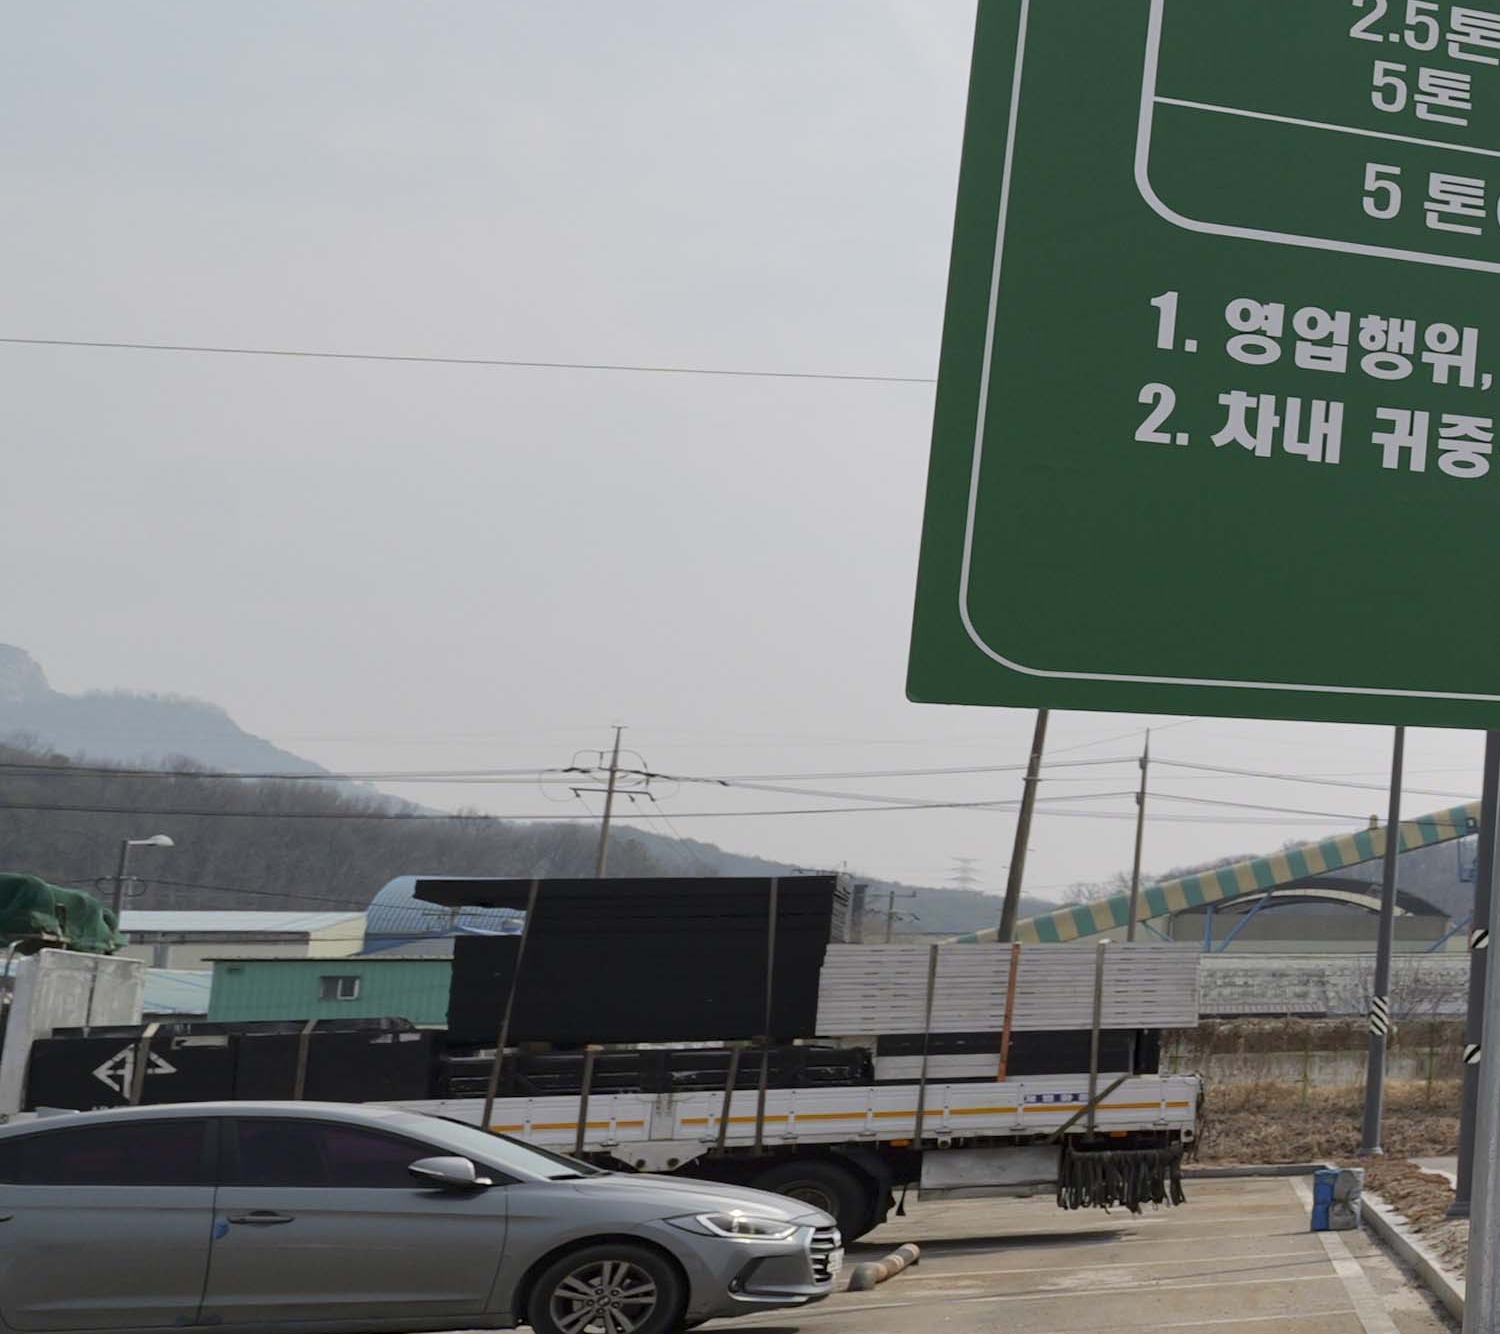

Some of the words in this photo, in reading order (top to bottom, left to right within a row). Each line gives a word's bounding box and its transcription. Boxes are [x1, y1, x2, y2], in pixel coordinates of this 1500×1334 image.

[1371, 60, 1472, 127] 5톤
[1150, 291, 1198, 353] 1.
[1225, 298, 1493, 391] 영업행위,
[1134, 382, 1189, 446] 2.
[1210, 390, 1344, 464] 차내
